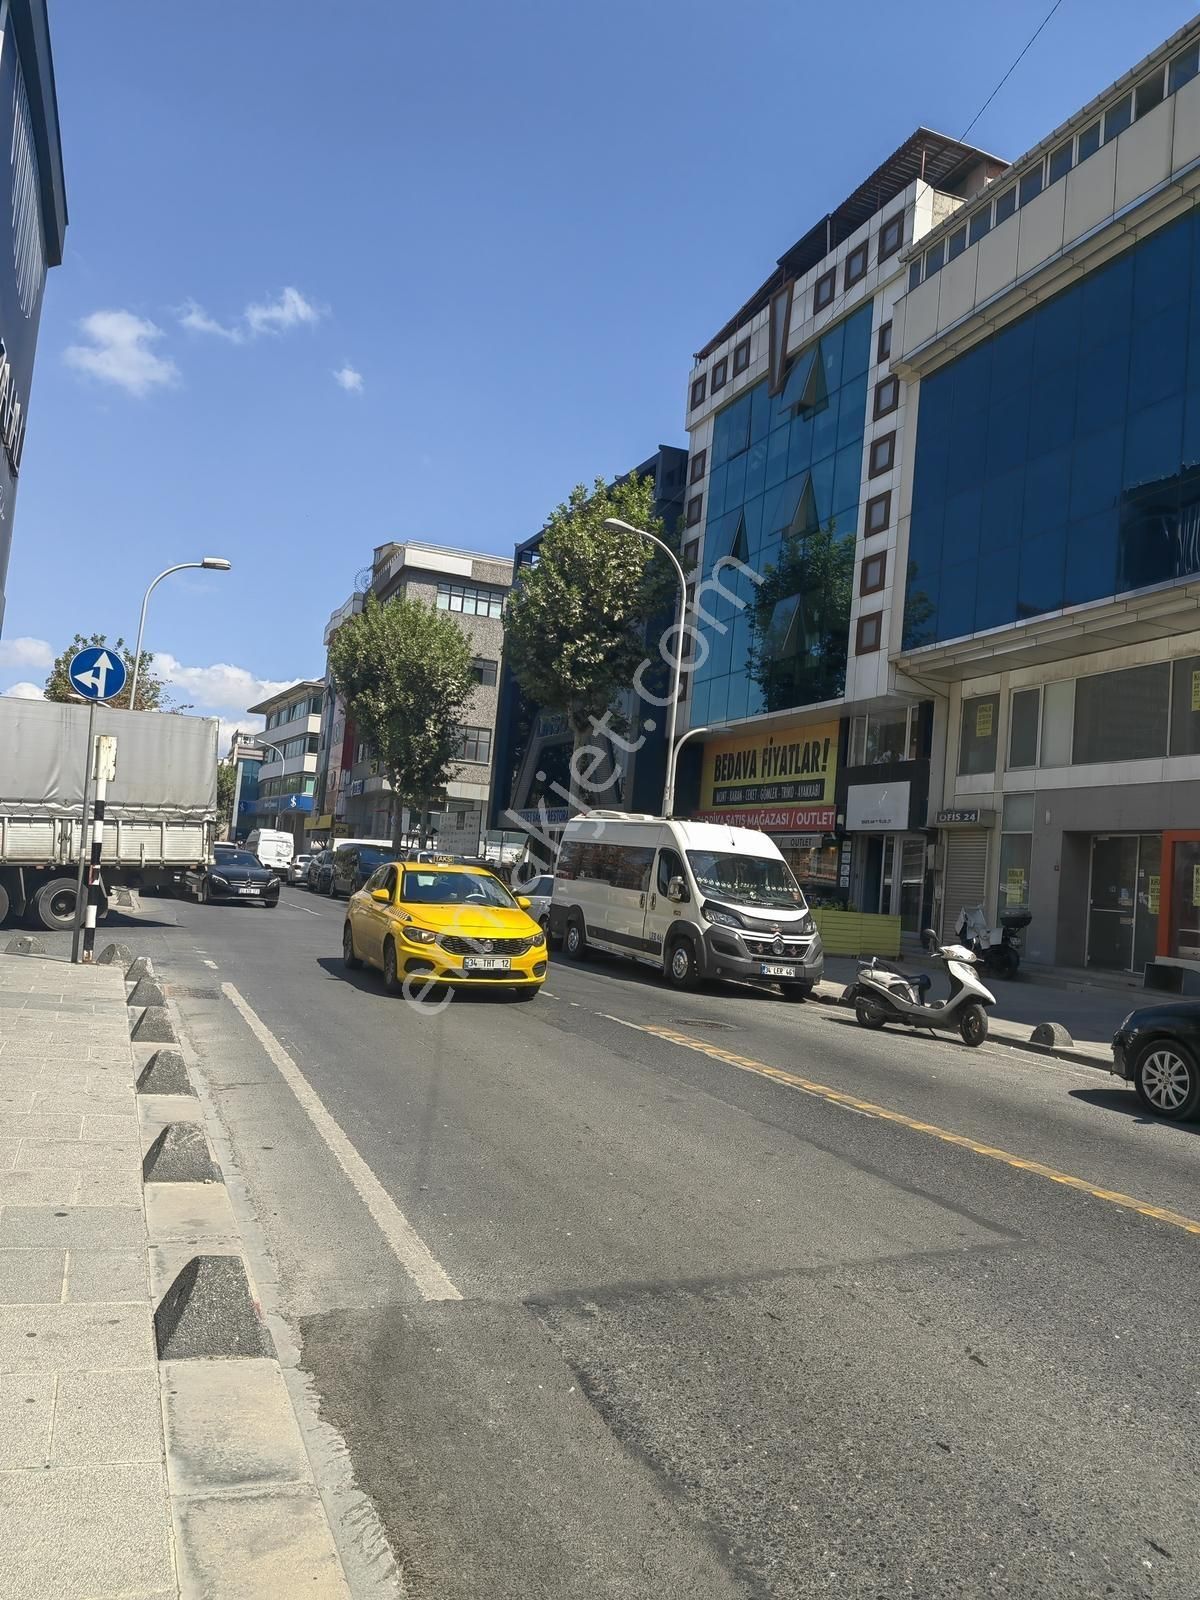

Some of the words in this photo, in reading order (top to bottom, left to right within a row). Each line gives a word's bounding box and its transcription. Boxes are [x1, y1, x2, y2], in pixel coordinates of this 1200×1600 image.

[714, 750, 757, 782] BEDAVA
[761, 737, 830, 778] FİYATLAR!
[747, 810, 789, 825] MAĞAZASI
[797, 812, 834, 825] OUTLET
[963, 813, 977, 821] 24
[791, 838, 812, 847] OUTLET
[468, 959, 478, 967] 34
[483, 959, 496, 967] THT
[502, 959, 509, 967] 12
[773, 967, 784, 975] LER
